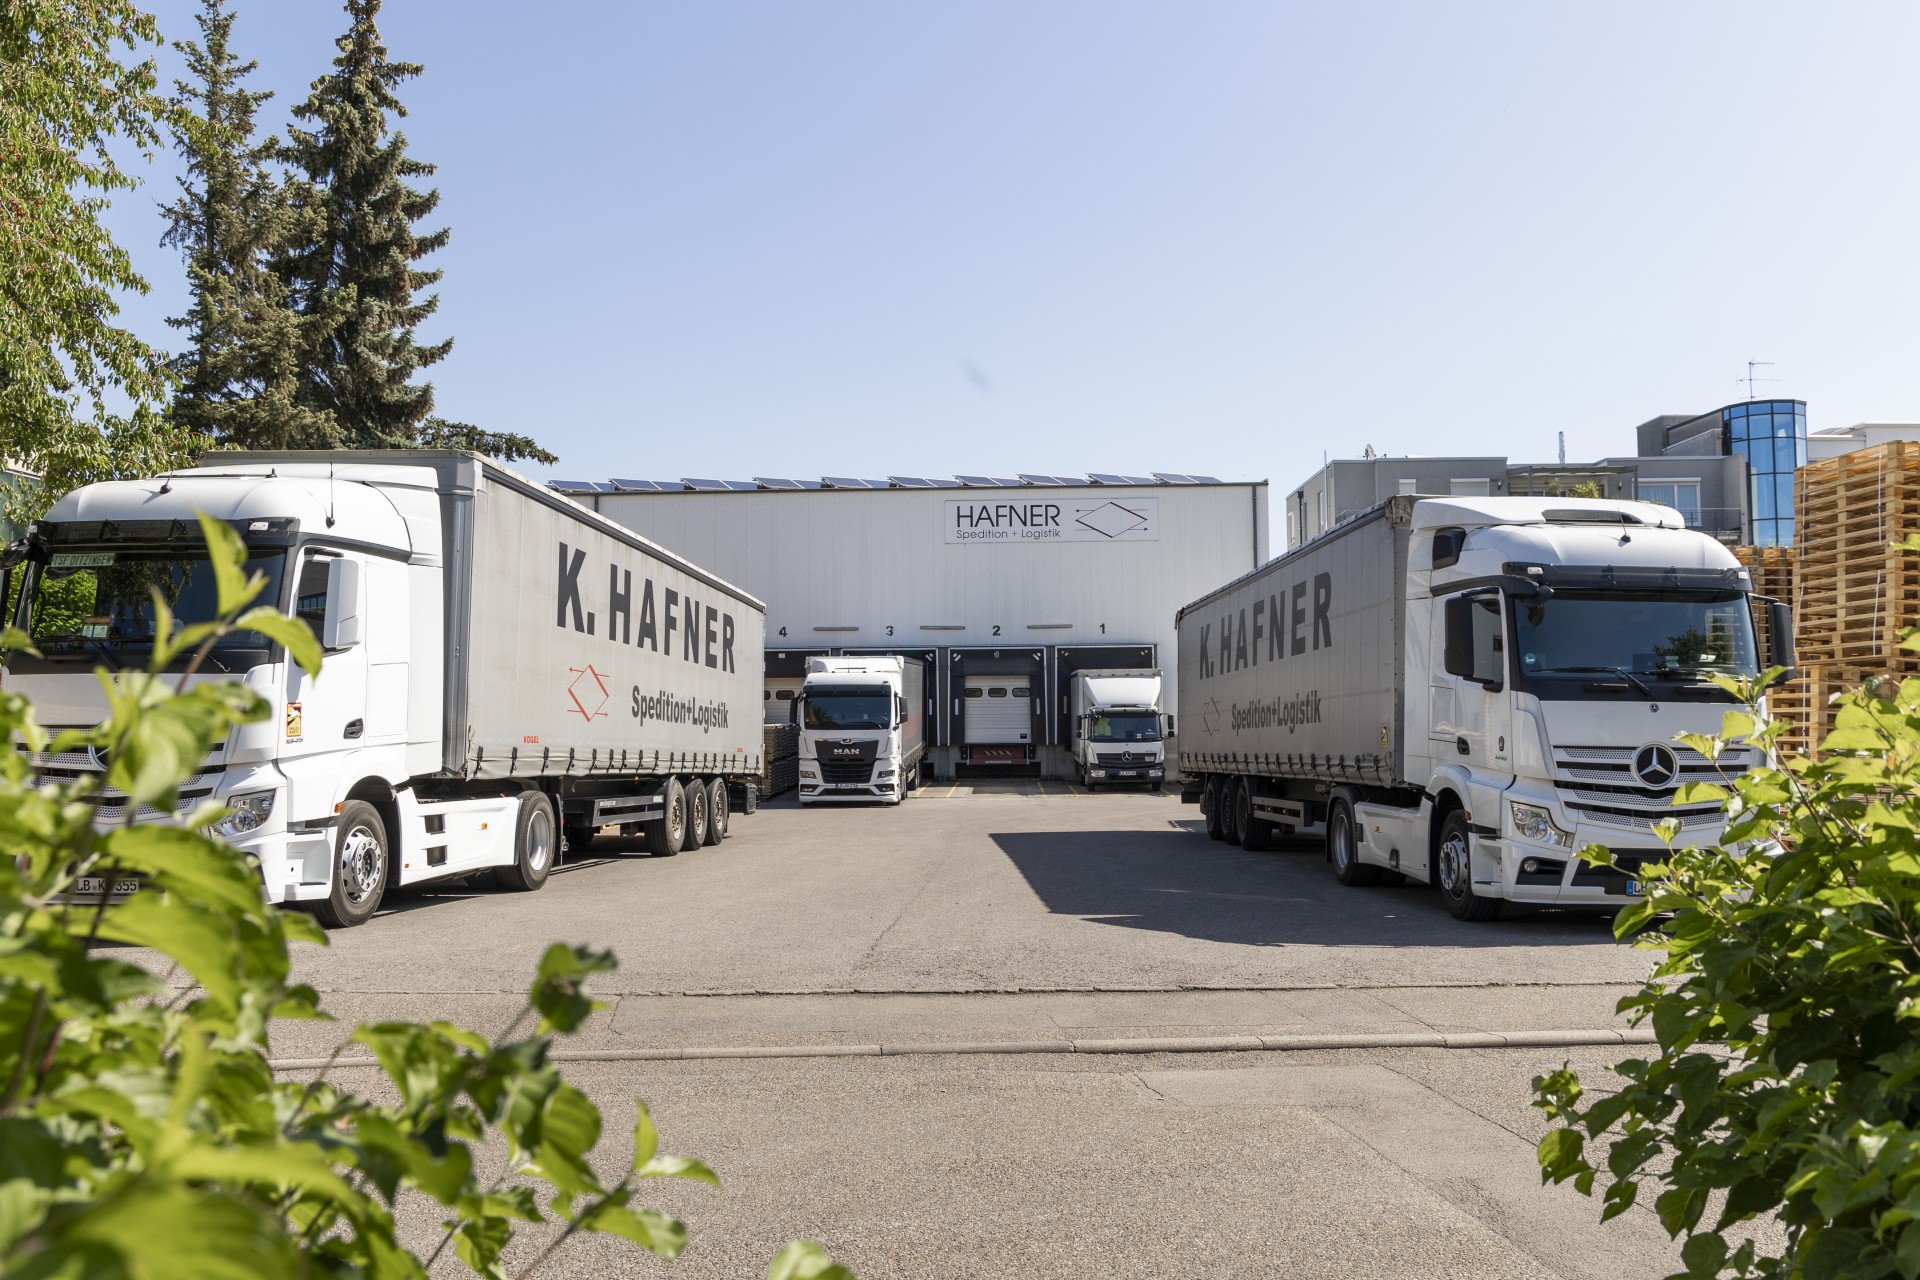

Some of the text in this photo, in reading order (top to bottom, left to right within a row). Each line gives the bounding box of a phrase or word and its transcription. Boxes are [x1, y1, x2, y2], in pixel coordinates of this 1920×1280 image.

[956, 504, 1061, 528] HAFNER
[956, 529, 1008, 540] Spedition
[1021, 528, 1061, 540] Logistik
[70, 554, 113, 566] DITZINGEN
[556, 541, 736, 675] K. HAFNER
[885, 625, 895, 637] 3
[992, 625, 1001, 637] 2
[1098, 623, 1106, 635] 1
[1199, 571, 1333, 680] K. HAFNER
[778, 626, 788, 638] 4
[76, 879, 91, 892] LB
